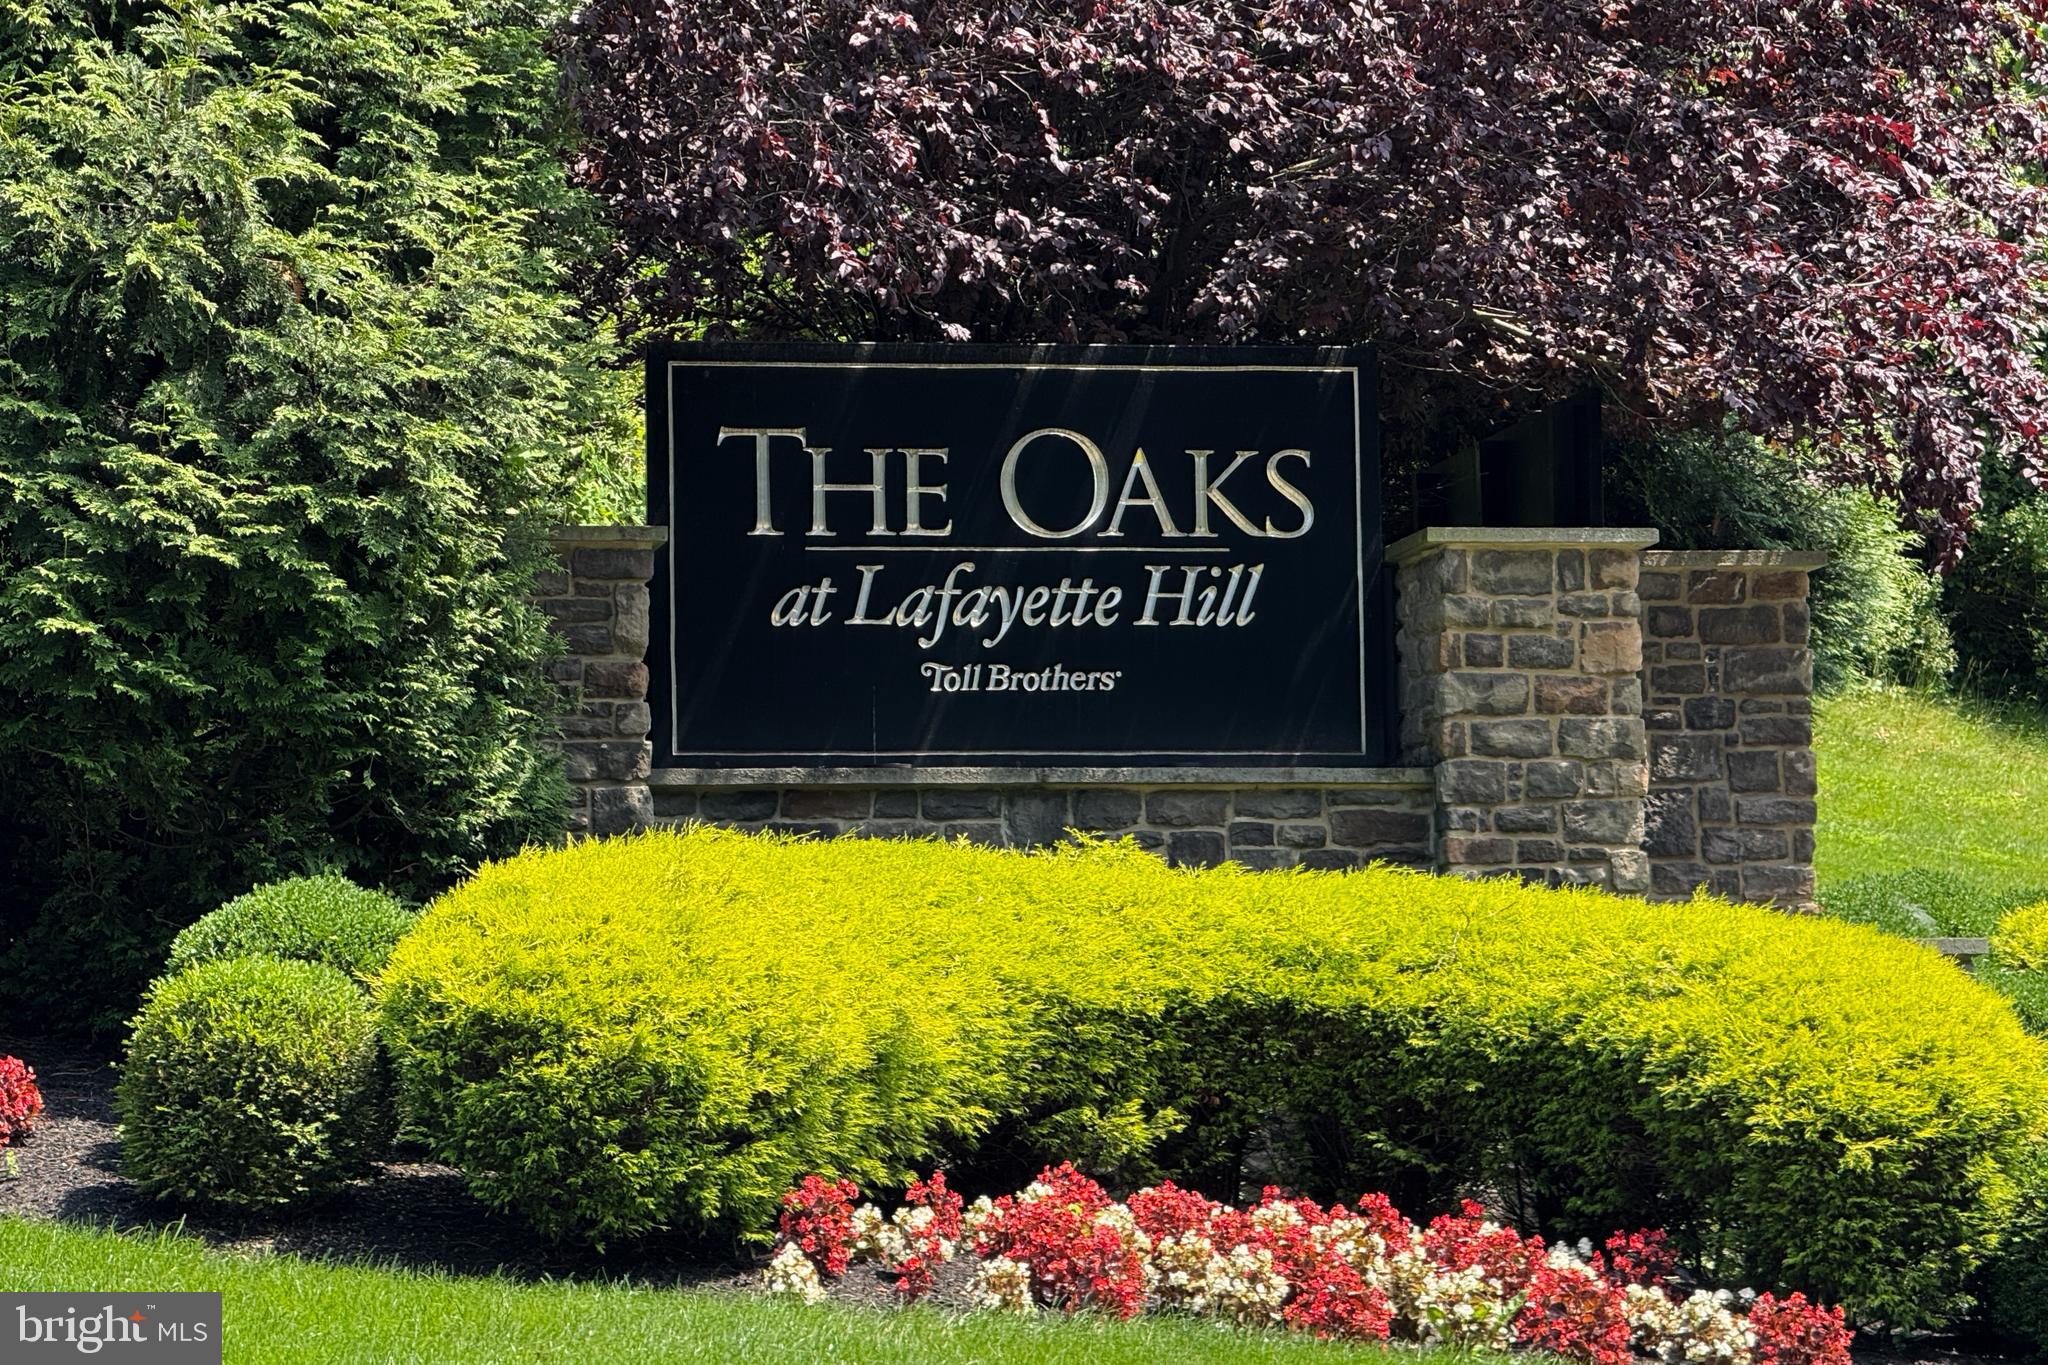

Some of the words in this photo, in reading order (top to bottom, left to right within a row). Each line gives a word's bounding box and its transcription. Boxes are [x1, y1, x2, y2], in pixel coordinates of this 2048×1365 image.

[717, 426, 952, 537] THE
[1000, 427, 1315, 539] OAKS
[770, 577, 837, 627] at
[844, 562, 1122, 648] Lafayette
[1132, 563, 1265, 627] Hill
[920, 661, 982, 692] Toll
[985, 663, 1116, 692] Brothers
